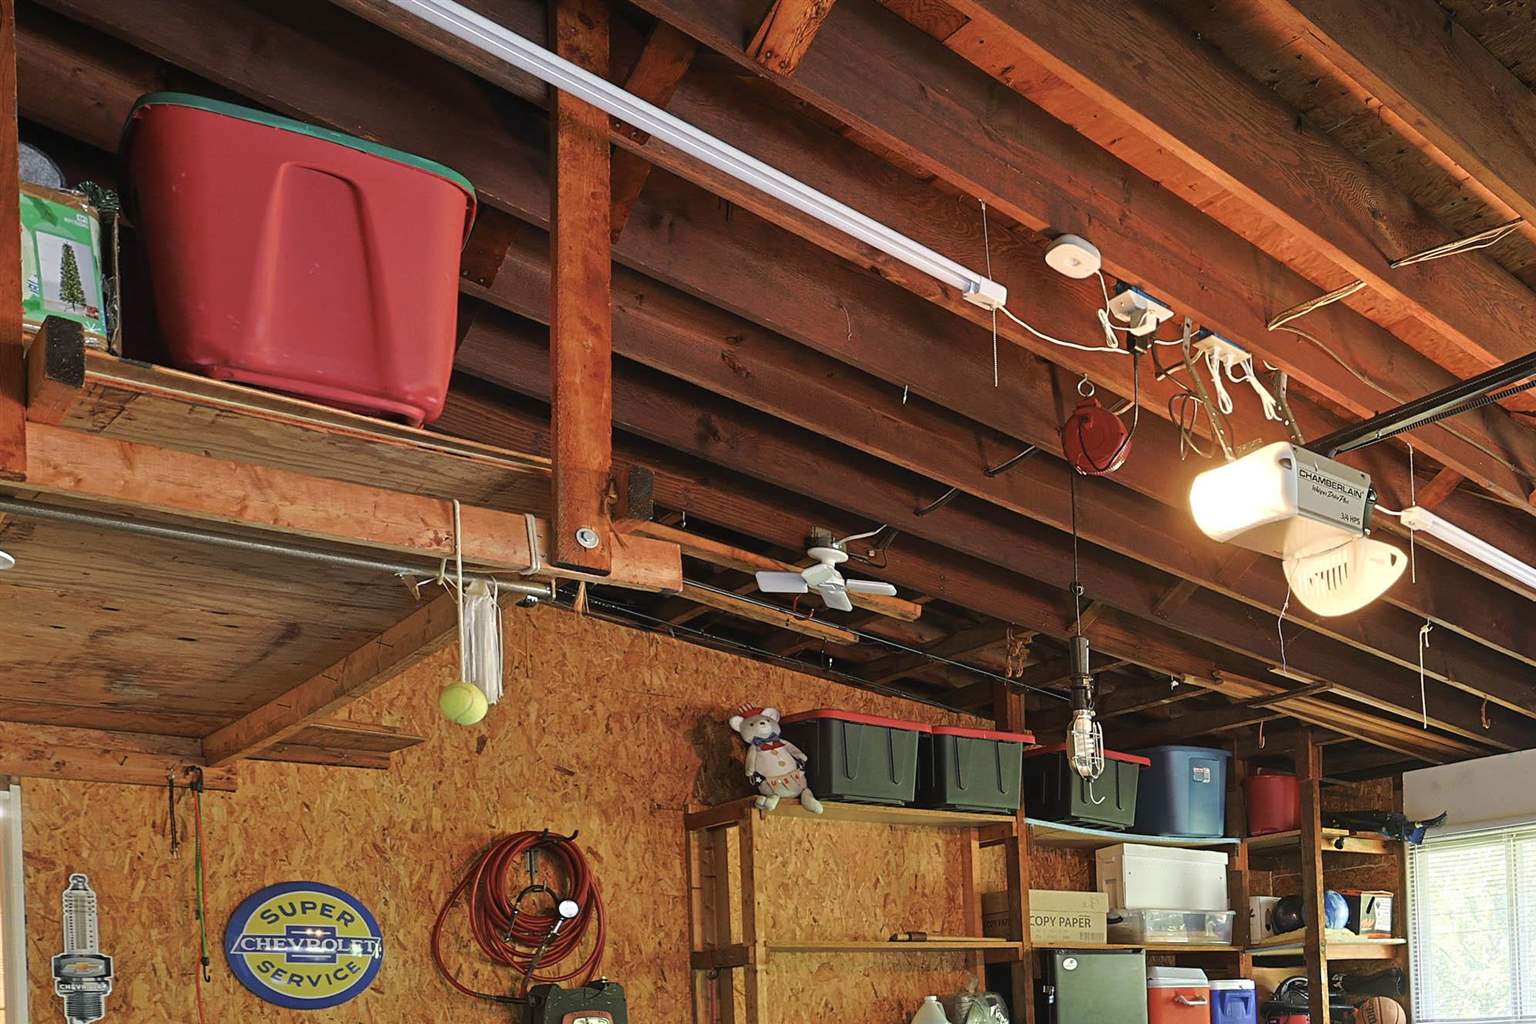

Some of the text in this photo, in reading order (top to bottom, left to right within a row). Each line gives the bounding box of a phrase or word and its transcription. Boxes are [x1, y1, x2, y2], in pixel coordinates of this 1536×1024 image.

[1299, 469, 1362, 499] CHAMBERLAIN
[260, 901, 356, 927] SUPER
[1030, 915, 1092, 929] COPY PAPER
[240, 937, 376, 952] CHEVROLET
[257, 960, 361, 988] SERVICE
